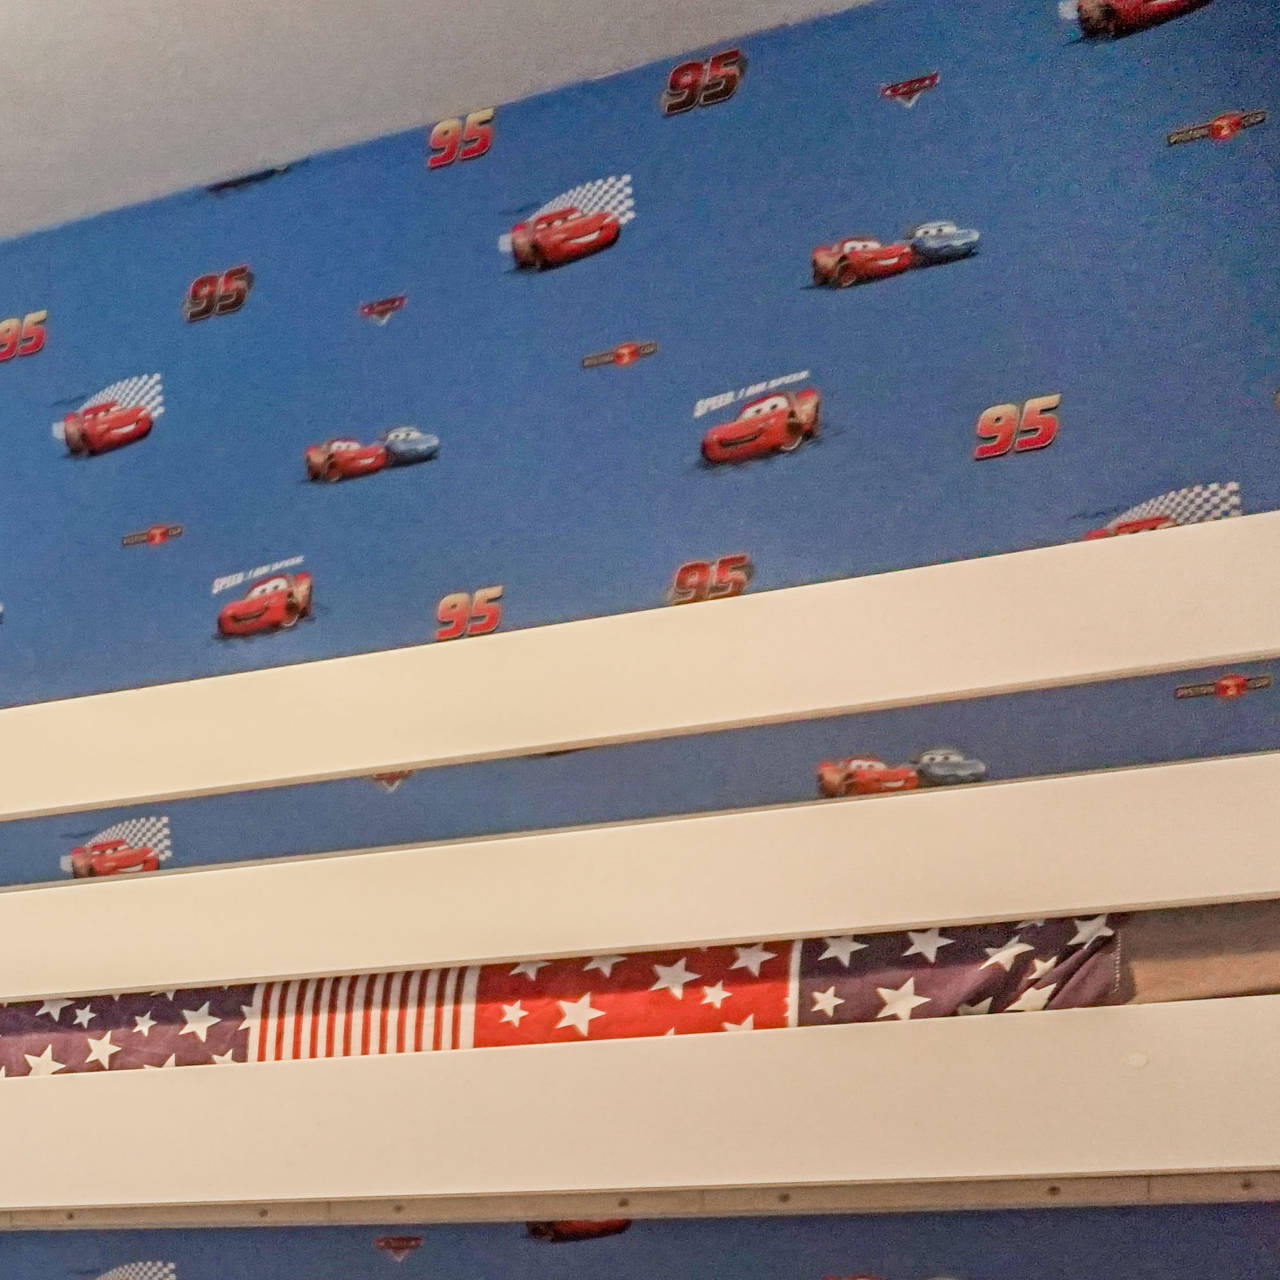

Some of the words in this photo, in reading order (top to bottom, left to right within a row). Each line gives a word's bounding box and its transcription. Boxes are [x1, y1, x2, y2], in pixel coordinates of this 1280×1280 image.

[664, 49, 743, 115] 95
[428, 107, 495, 170] 95
[187, 263, 251, 322] 95
[973, 393, 1061, 460] 95
[670, 552, 751, 606] 95
[436, 585, 504, 641] 95
